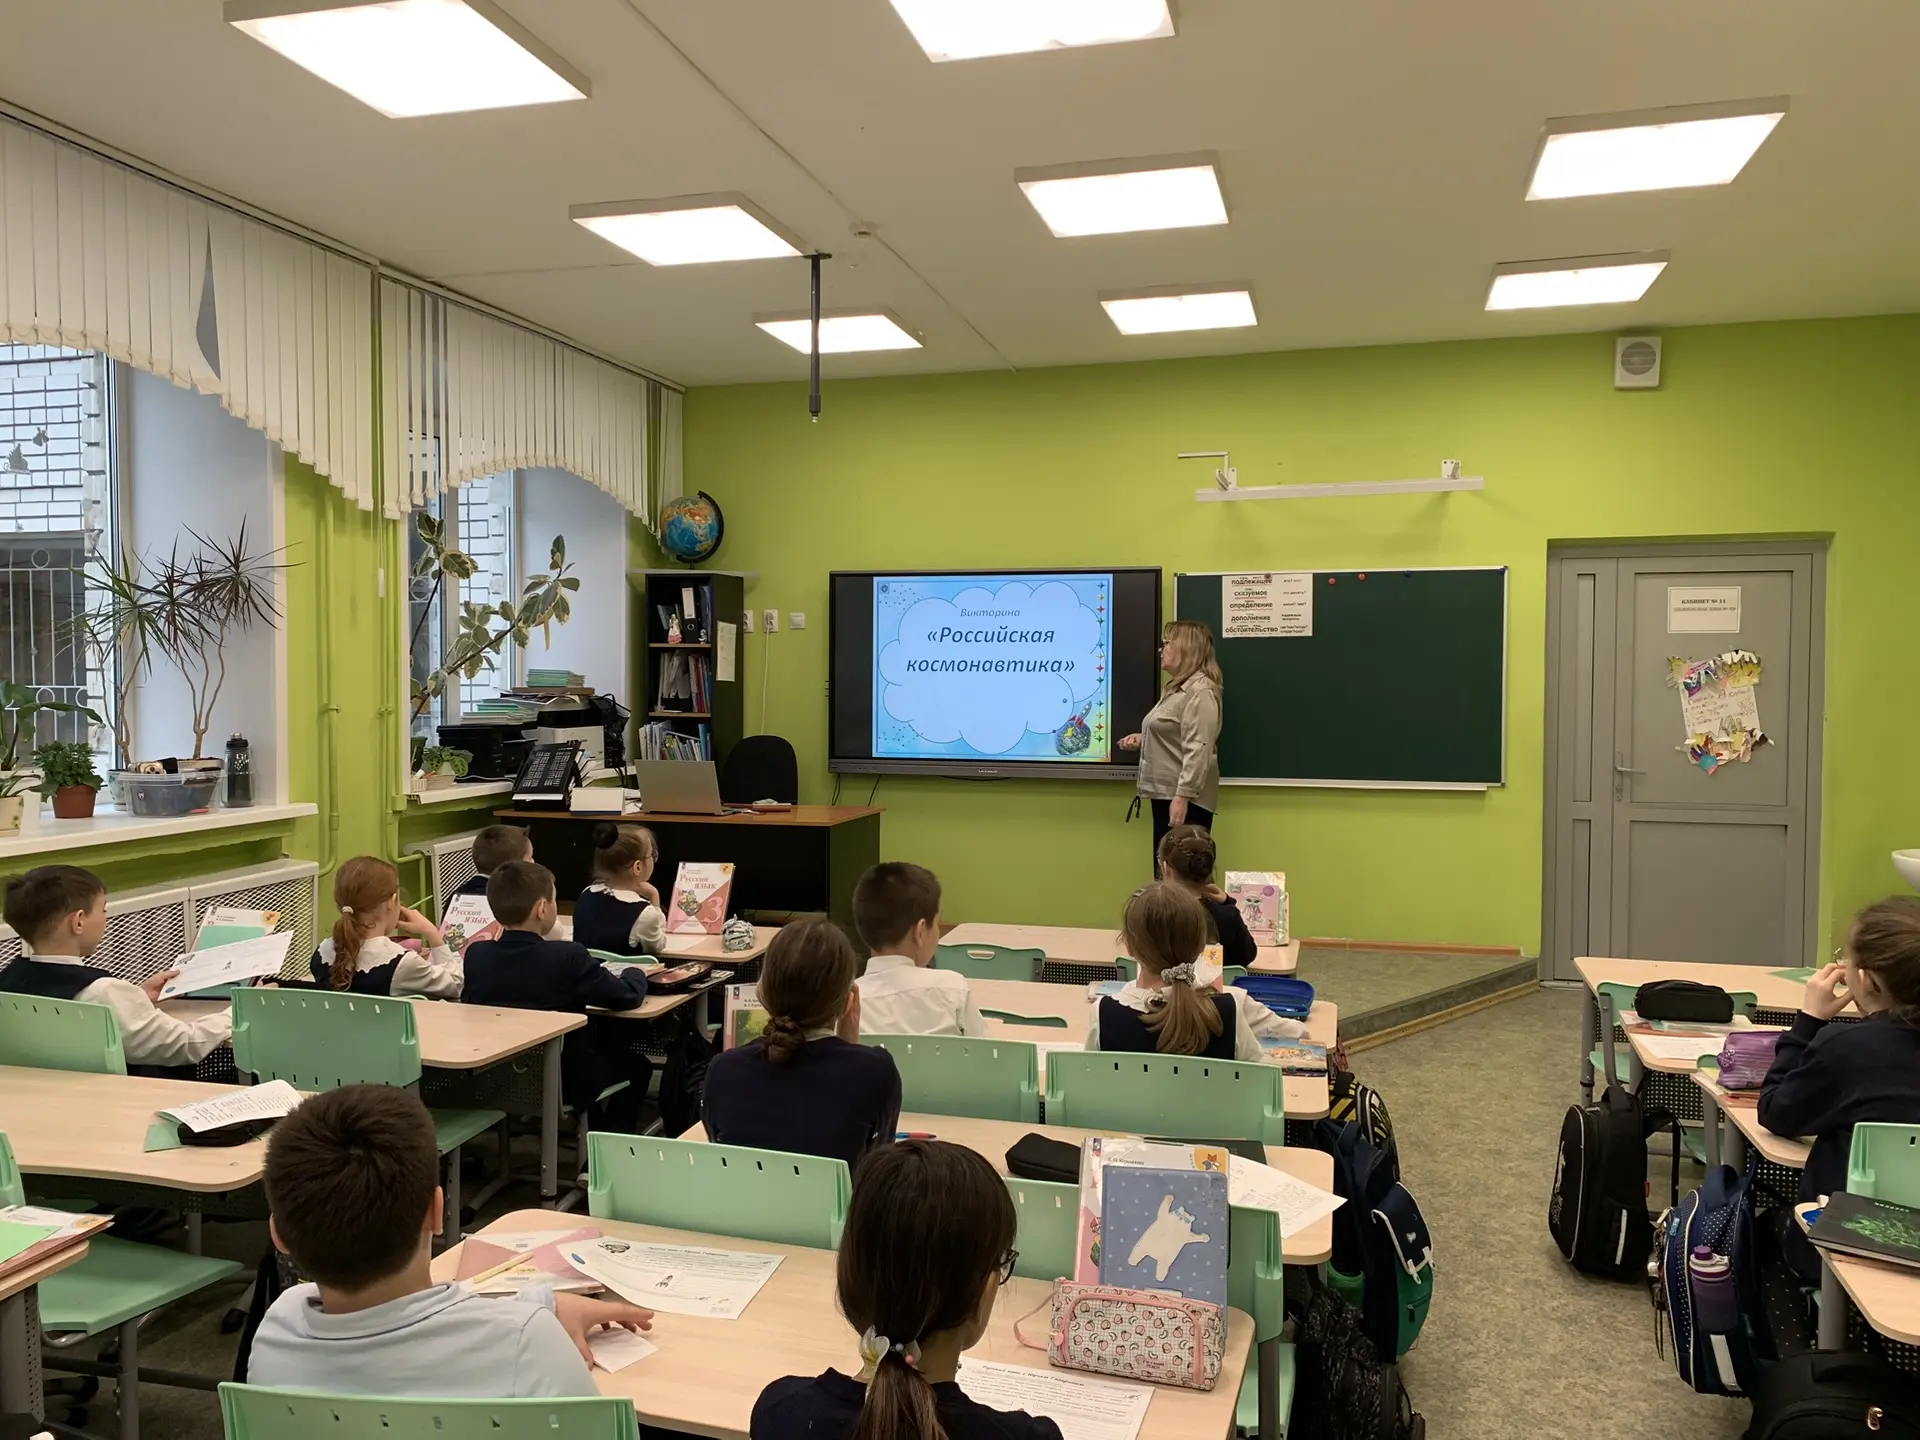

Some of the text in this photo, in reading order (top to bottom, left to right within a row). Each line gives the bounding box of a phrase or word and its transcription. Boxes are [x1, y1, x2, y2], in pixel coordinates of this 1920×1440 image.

[960, 608, 1021, 618] Викторина
[927, 625, 1055, 643] «Российская
[906, 659, 1075, 673] космонавтика»
[680, 874, 709, 882] Русский
[450, 906, 482, 916] Русский
